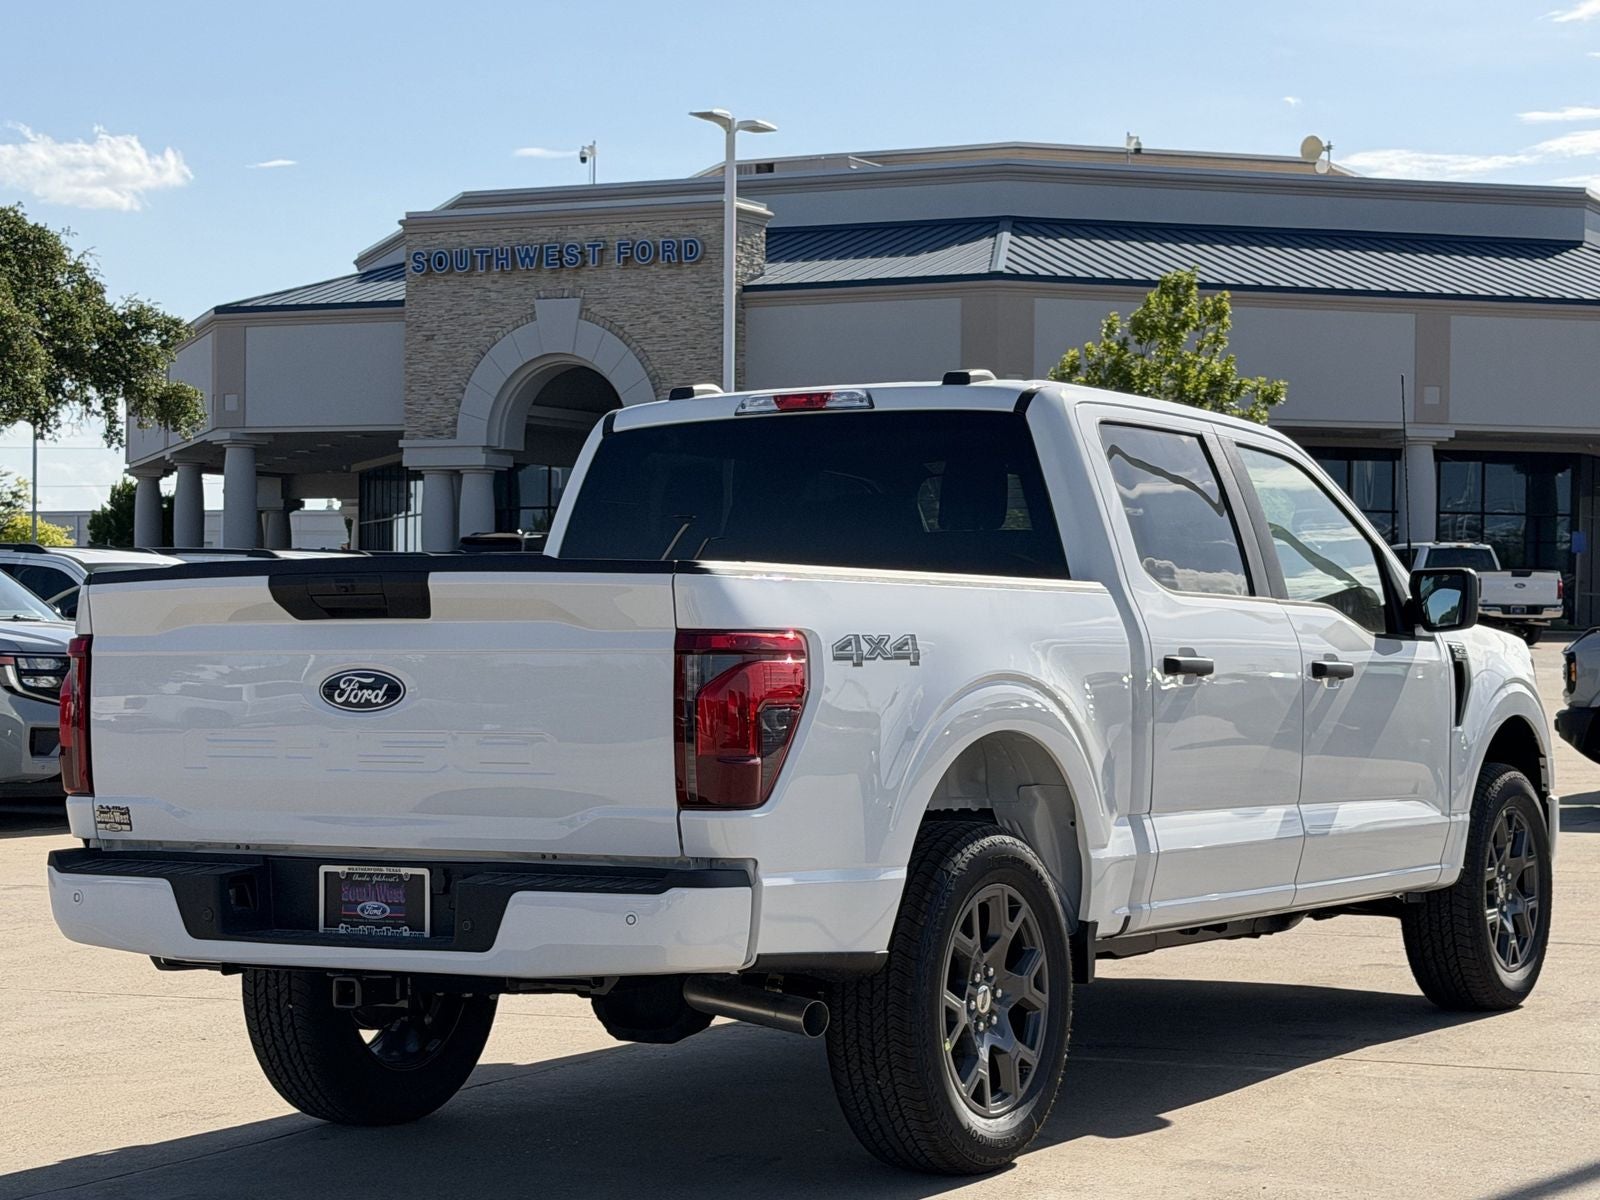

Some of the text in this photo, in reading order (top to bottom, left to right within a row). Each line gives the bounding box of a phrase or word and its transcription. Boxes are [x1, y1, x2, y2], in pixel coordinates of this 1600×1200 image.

[411, 238, 702, 273] SOUTHWEST FORD
[334, 676, 388, 704] Ford
